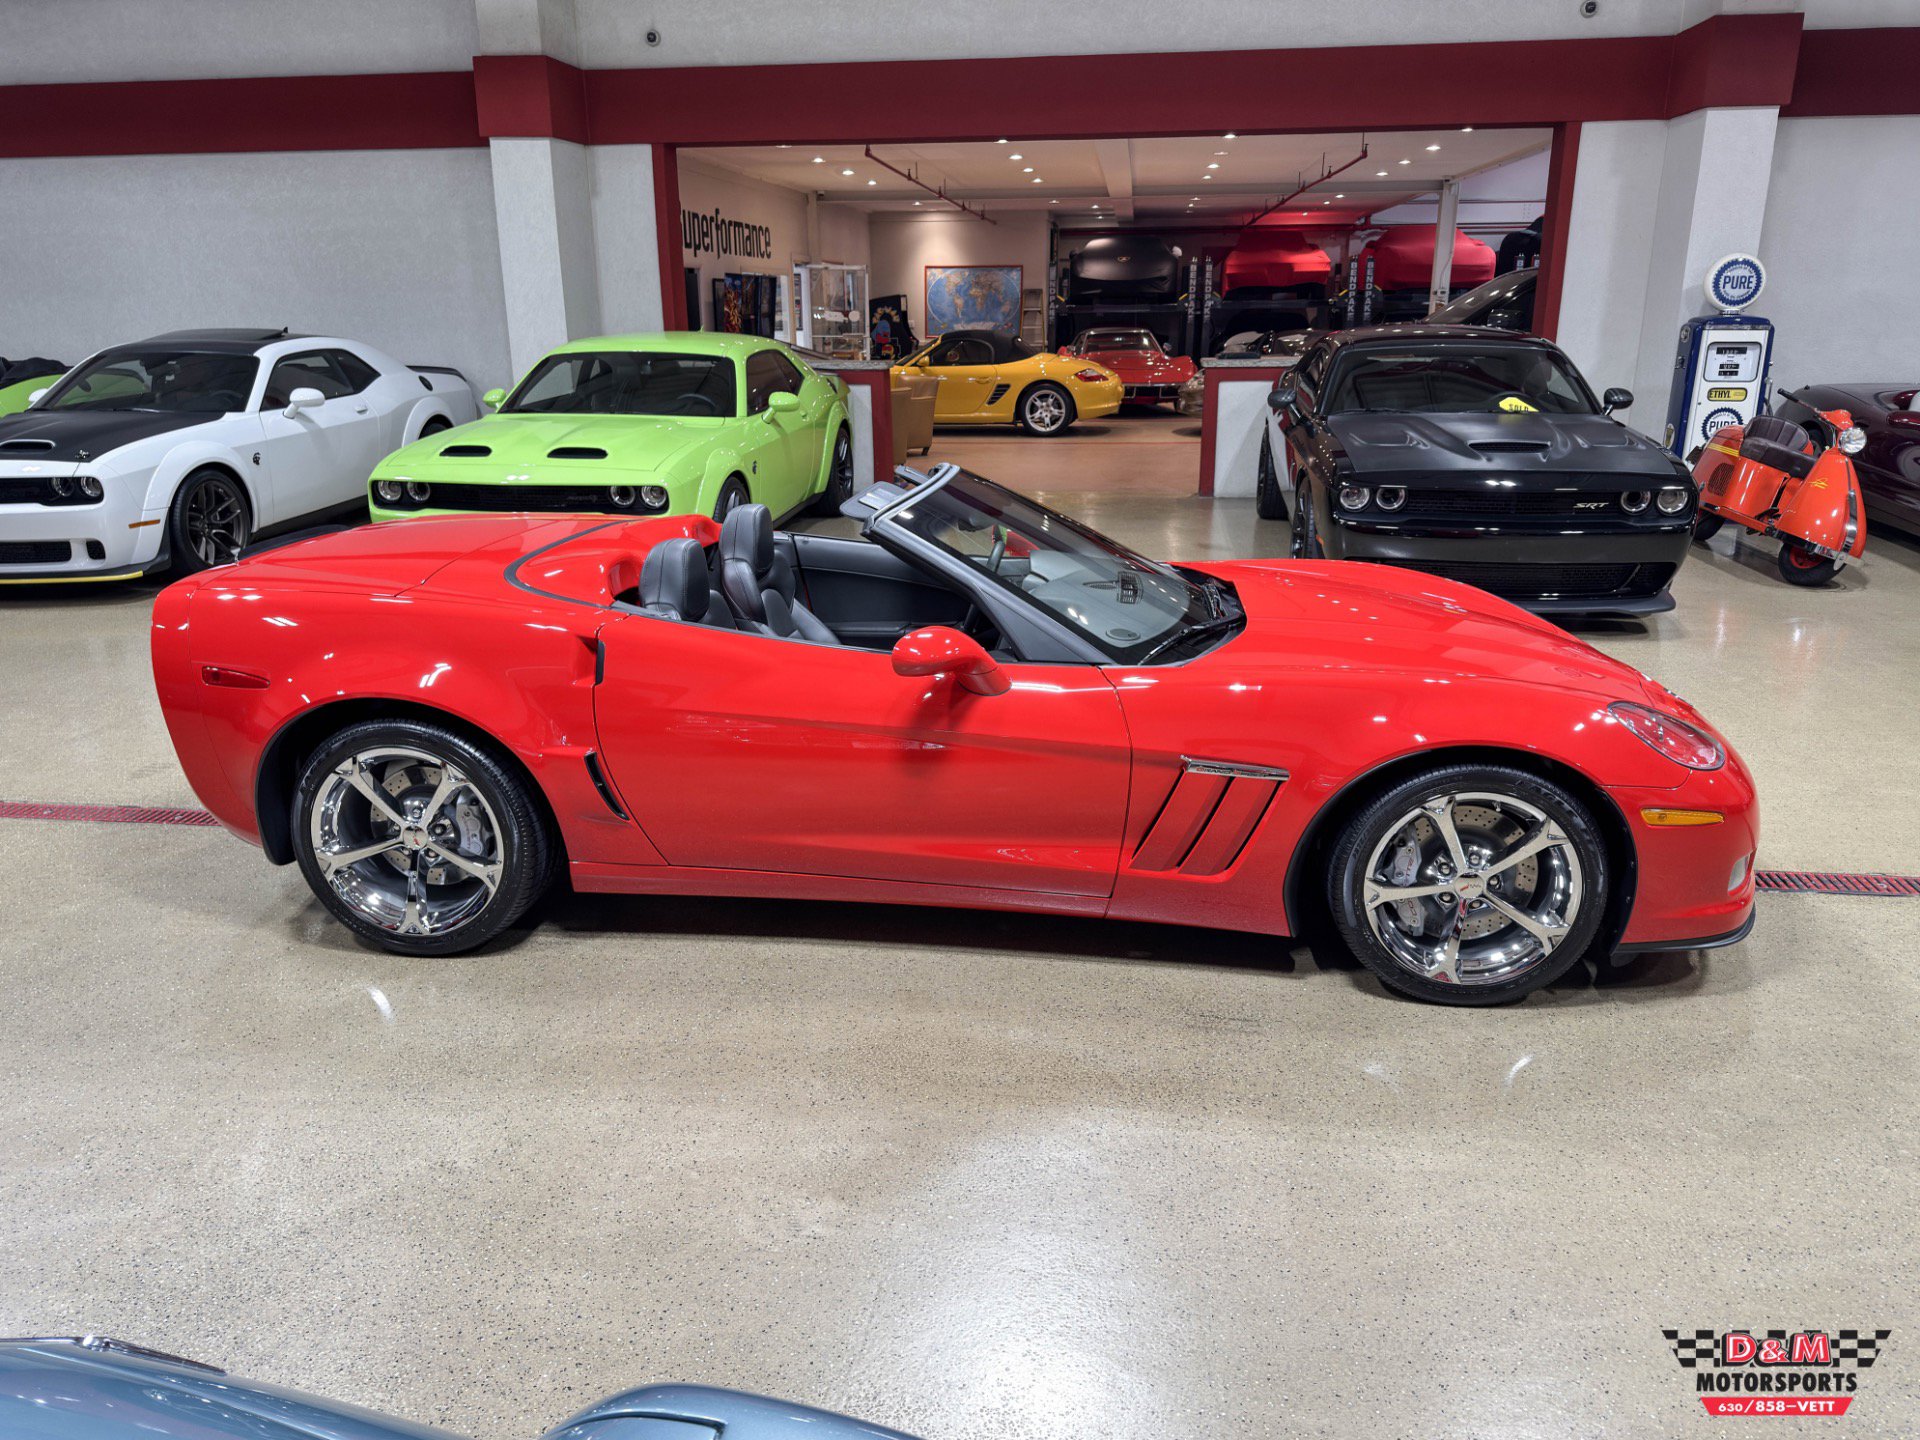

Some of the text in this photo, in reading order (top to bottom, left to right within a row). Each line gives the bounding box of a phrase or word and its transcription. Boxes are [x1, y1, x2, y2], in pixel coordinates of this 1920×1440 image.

[681, 208, 771, 259] uperformance
[1722, 275, 1754, 290] PURE
[1709, 390, 1732, 399] ETHYL
